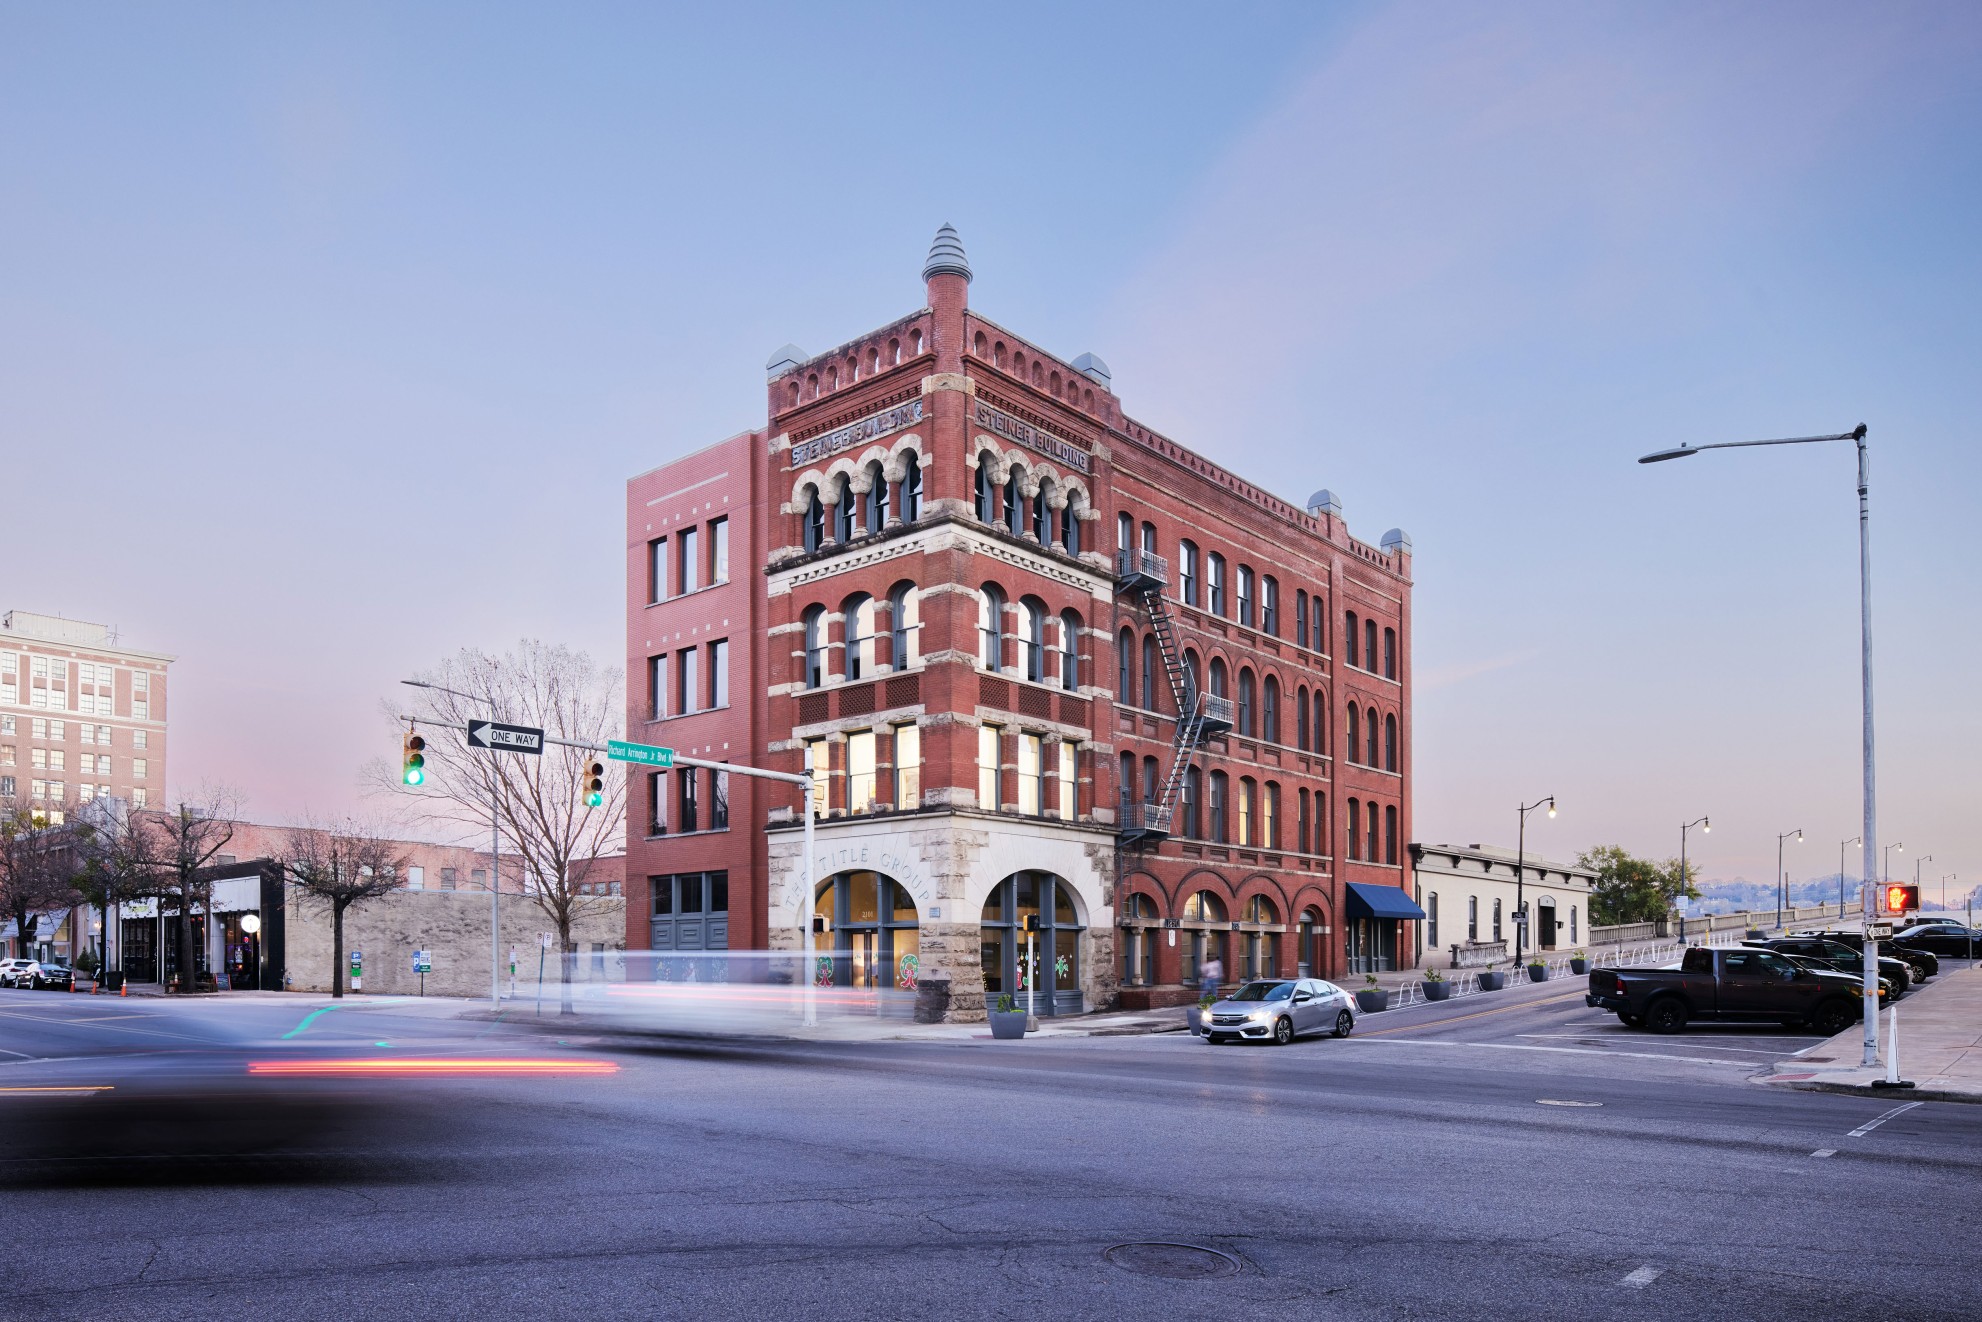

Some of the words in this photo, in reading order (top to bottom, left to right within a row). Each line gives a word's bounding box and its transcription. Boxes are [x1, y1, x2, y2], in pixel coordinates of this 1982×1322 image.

[979, 408, 1031, 444] STEINER
[1035, 431, 1087, 469] BUILDING
[491, 731, 511, 743] ONE
[515, 733, 535, 746] WAY
[608, 745, 626, 757] Richard
[627, 747, 648, 762] Arrington
[650, 750, 656, 761] Jr
[657, 751, 667, 763] Blvd
[818, 848, 869, 871] TITLE
[881, 853, 930, 902] GROUP
